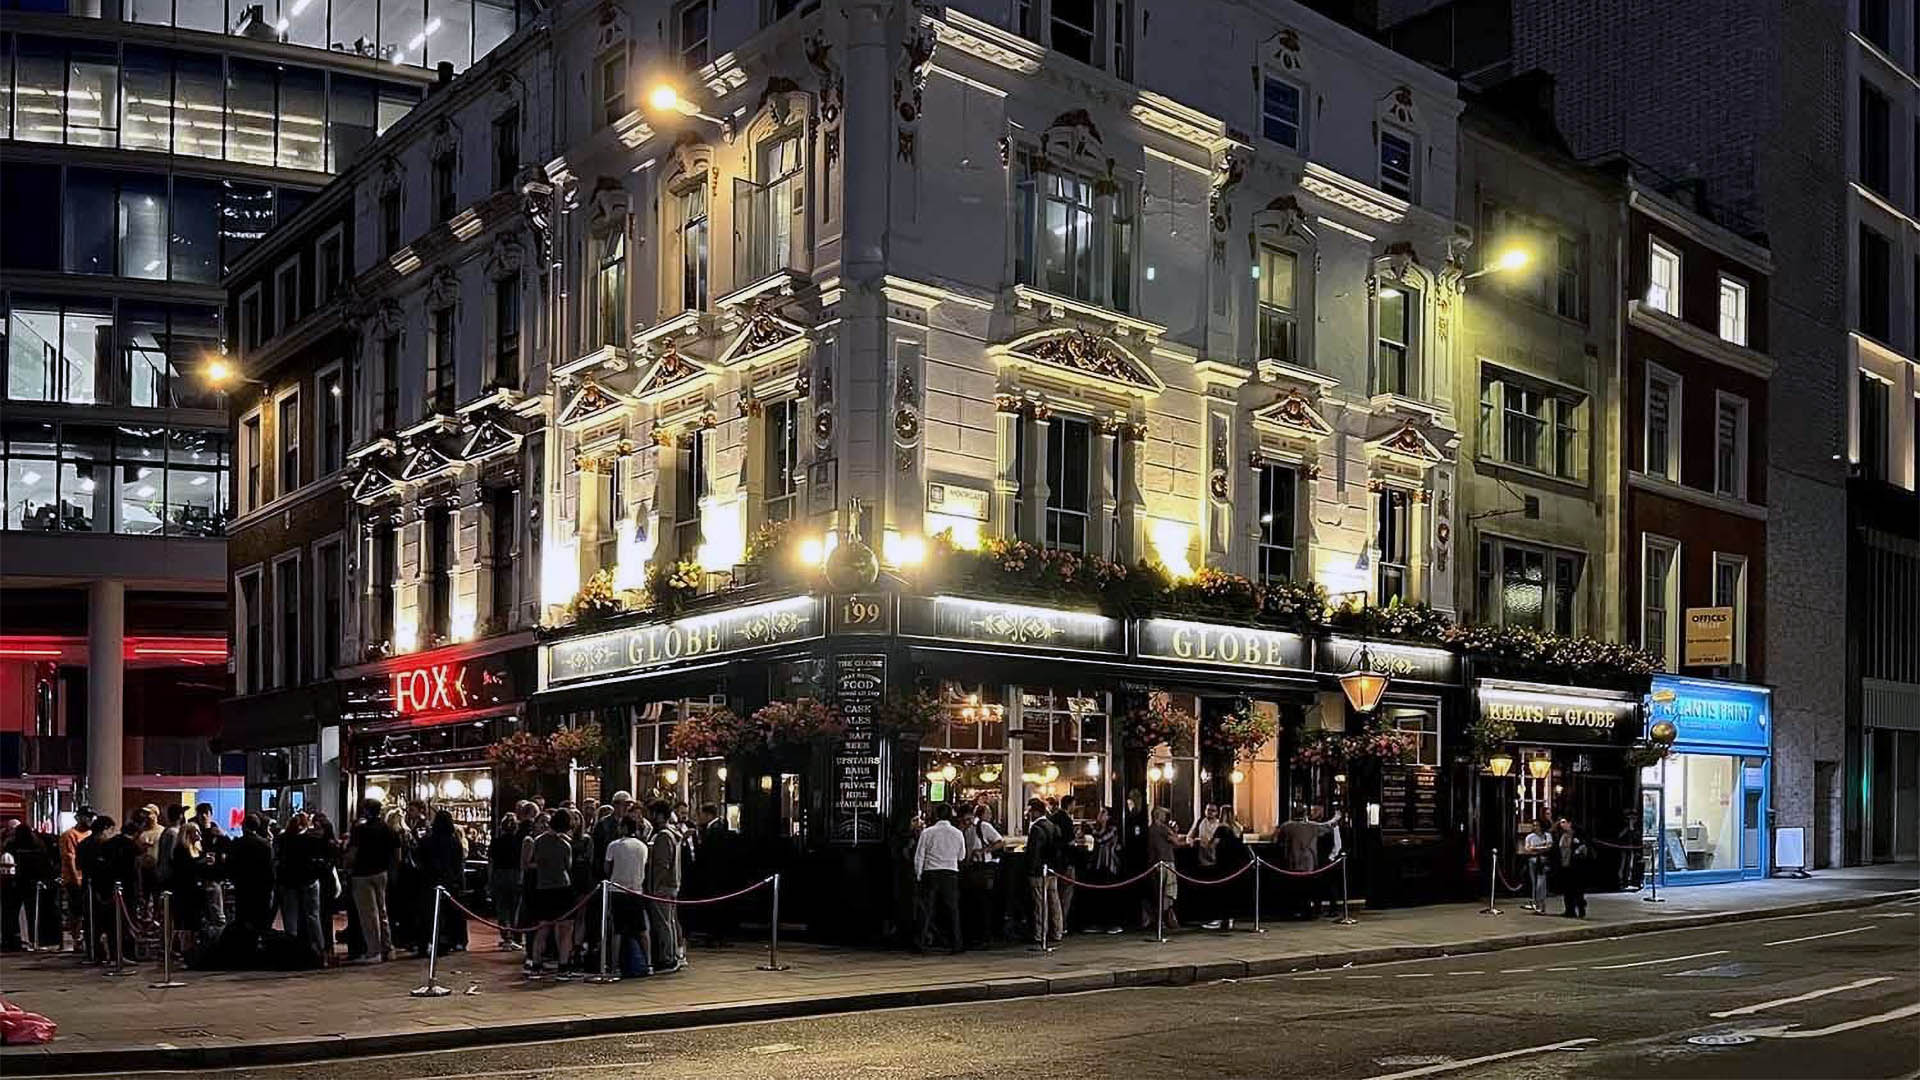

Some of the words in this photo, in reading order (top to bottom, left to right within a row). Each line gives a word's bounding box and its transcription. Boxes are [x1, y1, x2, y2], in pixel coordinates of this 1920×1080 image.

[843, 602, 880, 624] 199
[628, 622, 720, 665] GLOBE
[1172, 627, 1282, 666] GLOBE
[843, 681, 874, 689] FOOD
[844, 704, 872, 713] CASK
[1488, 703, 1544, 723] KEATS
[1565, 708, 1616, 728] GLOBE
[1719, 703, 1752, 722] PRINT
